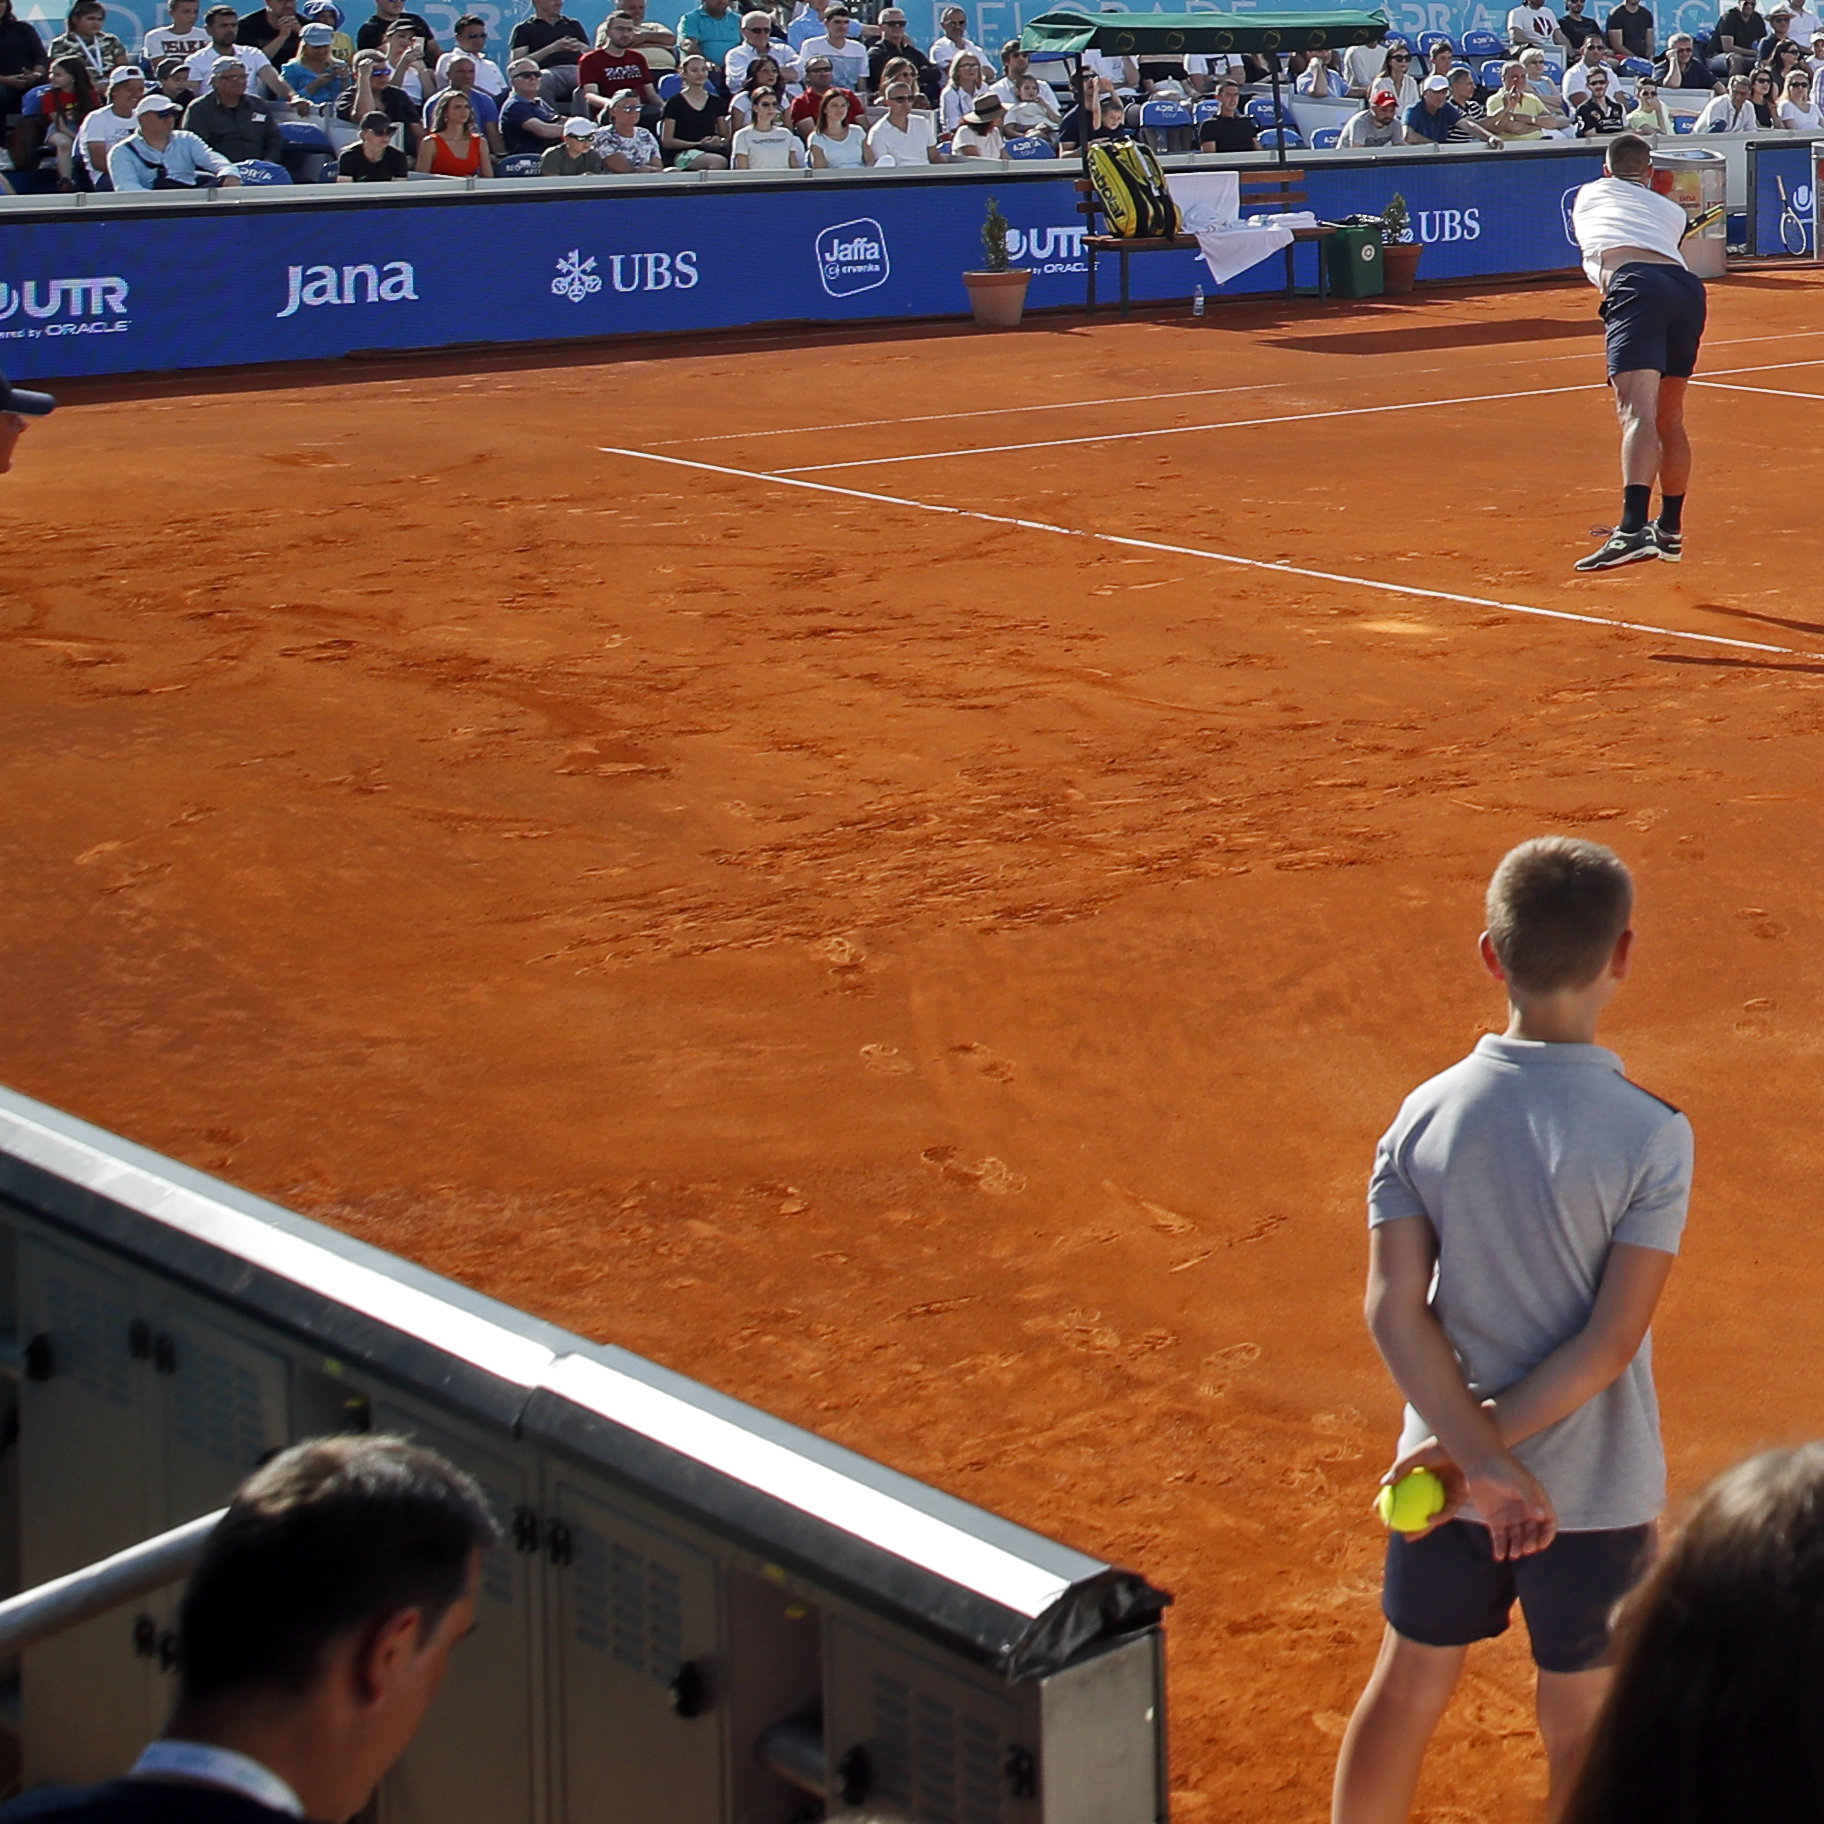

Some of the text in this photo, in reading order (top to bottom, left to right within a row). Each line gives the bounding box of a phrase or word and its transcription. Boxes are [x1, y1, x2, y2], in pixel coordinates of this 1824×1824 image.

[1418, 207, 1481, 243] UBS
[825, 237, 880, 262] Jaffa
[609, 250, 699, 293] UBS
[23, 276, 130, 319] UTR
[46, 320, 130, 337] ORACLE
